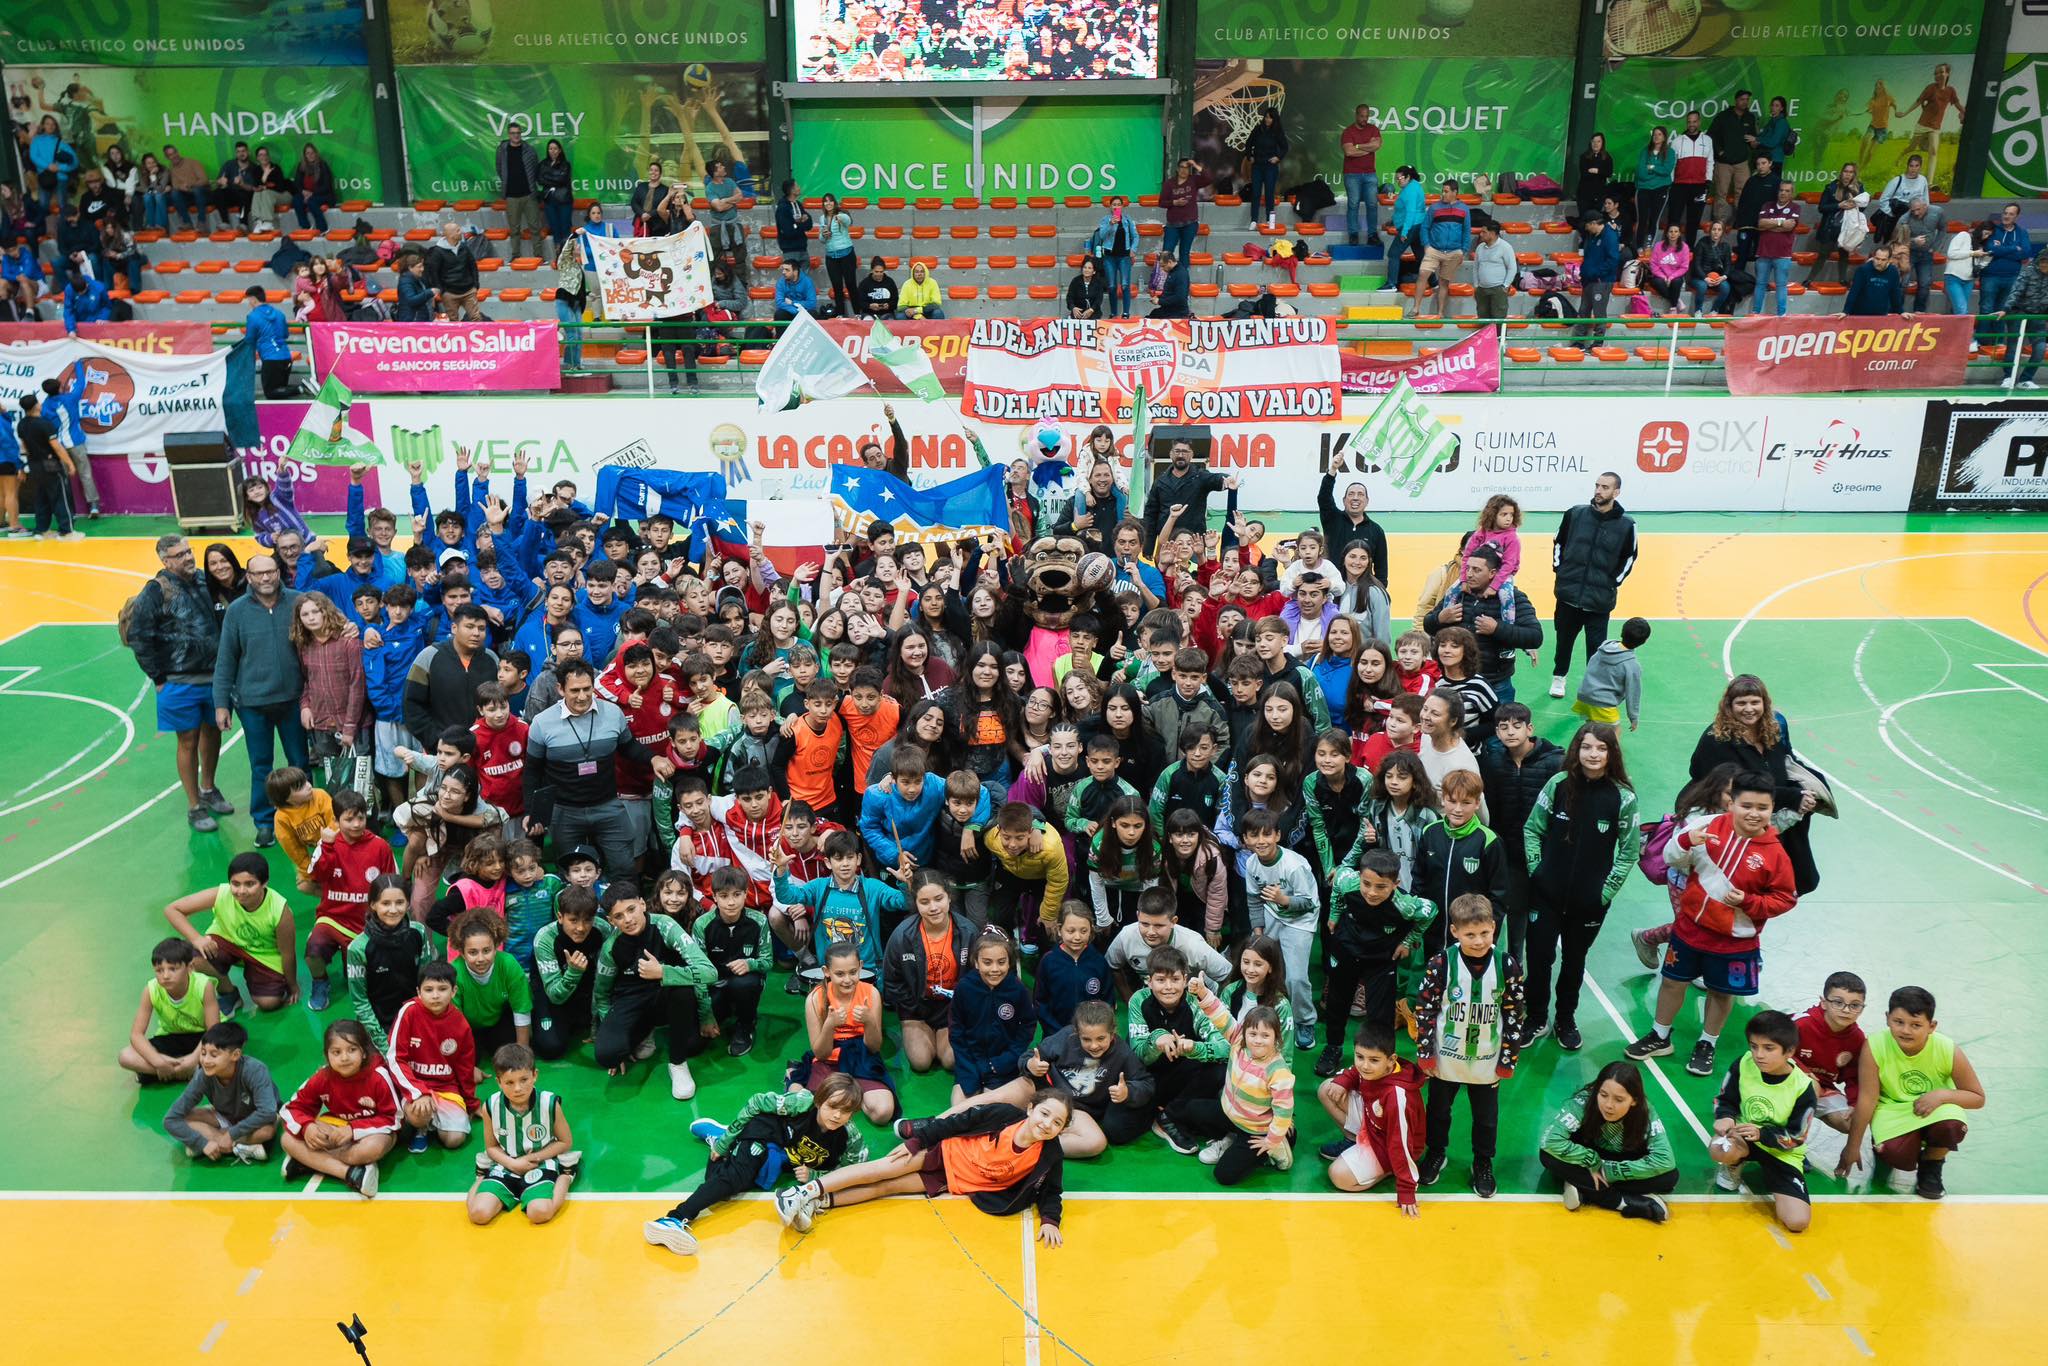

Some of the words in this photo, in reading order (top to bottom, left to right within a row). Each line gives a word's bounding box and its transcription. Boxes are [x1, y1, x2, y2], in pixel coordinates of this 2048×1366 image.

[513, 33, 553, 47] CLUB
[558, 33, 628, 46] ATLETICO
[635, 32, 680, 46] ONCE
[686, 31, 749, 45] UNIDOS
[1215, 28, 1254, 41] CLUB
[1259, 27, 1329, 40] ATLETICO
[1336, 27, 1381, 40] ONCE
[1387, 26, 1451, 40] UNIDOS
[1731, 25, 1771, 39] CLUB
[1776, 24, 1848, 38] ATLETICO
[1856, 24, 1902, 37] ONCE
[1907, 23, 1973, 37] UNIDOS
[133, 39, 177, 52] ONCE
[182, 38, 245, 52] UNIDOS
[162, 110, 334, 137] HANDBALL
[486, 111, 586, 137] VOLEY
[1366, 105, 1510, 134] BASQUET
[334, 178, 372, 191] IDOS
[431, 179, 469, 193] CLUB
[473, 179, 503, 192] ATLE
[571, 178, 590, 191] CE
[840, 162, 949, 191] ONCE
[964, 162, 1118, 191] UNIDOS
[333, 329, 467, 355] Prevención
[471, 328, 536, 353] Salud
[972, 318, 1099, 356] ADELANTE
[1187, 317, 1327, 351] JUVENTUD
[1757, 321, 1941, 366] opensports
[376, 361, 391, 372] de
[392, 360, 440, 372] SANCOR
[441, 359, 497, 371] SEGUROS
[1114, 349, 1172, 363] ESMERALDA
[1863, 356, 1918, 374] .com.ar
[0, 362, 35, 377] CLUB
[138, 397, 217, 416] OLAVARRIA
[974, 388, 1103, 421] ADELANTE
[1117, 406, 1133, 419] 10
[1183, 391, 1241, 419] CON
[1474, 431, 1557, 452] QUIMICA
[1694, 420, 1759, 453] SIX
[451, 439, 580, 474] VEGA
[757, 434, 799, 469] LA
[1472, 455, 1590, 473] INDUSTRIAL
[1691, 456, 1753, 475] electric
[328, 890, 369, 903] HURACA
[1449, 1002, 1467, 1022] LOS
[1469, 1003, 1498, 1025] ANDES
[1465, 1027, 1481, 1044] 12
